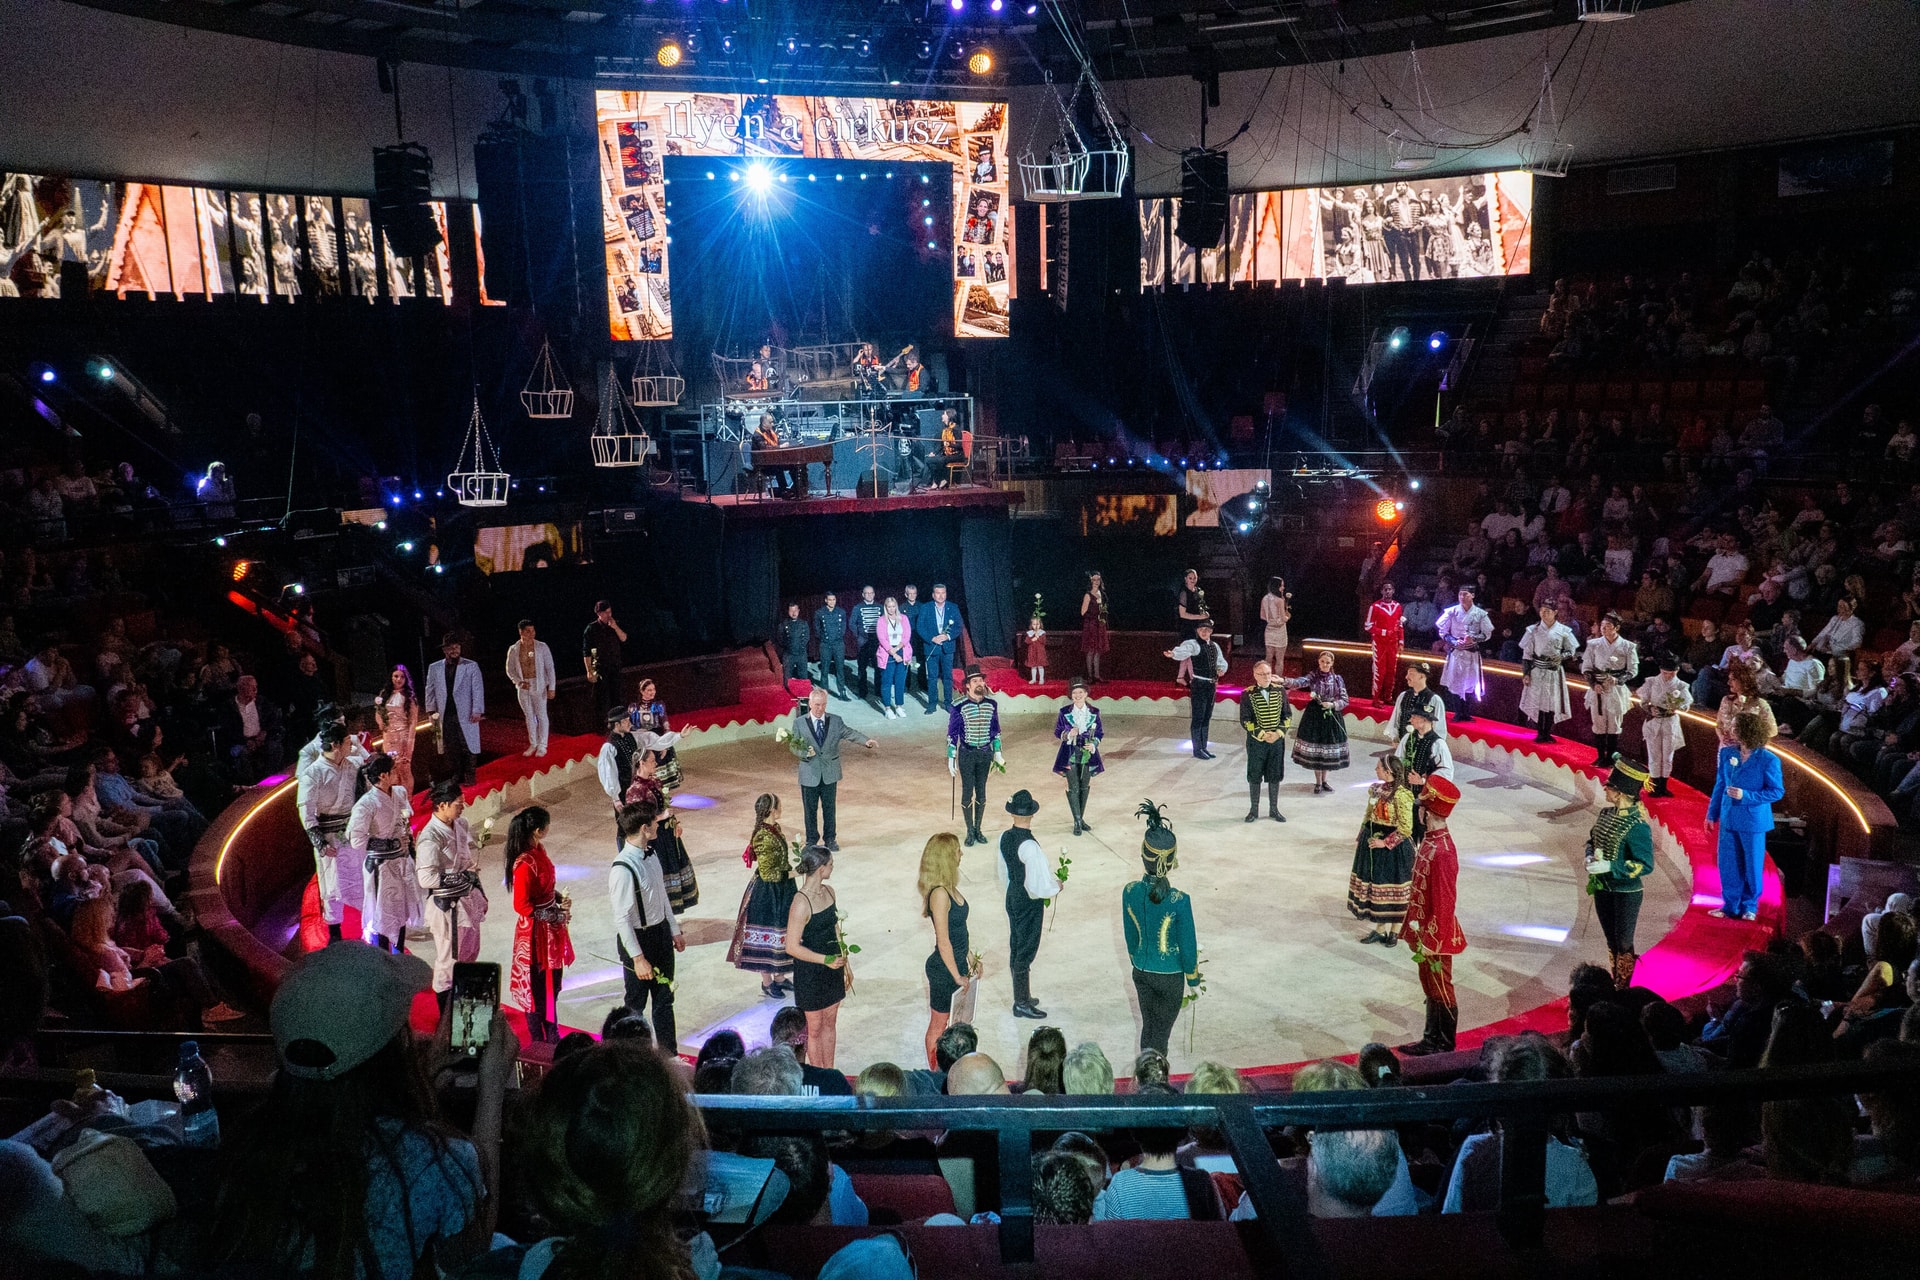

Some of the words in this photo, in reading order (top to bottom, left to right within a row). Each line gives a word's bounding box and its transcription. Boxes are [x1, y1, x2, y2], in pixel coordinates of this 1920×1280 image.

[664, 100, 766, 149] Ilyen
[780, 115, 804, 141] a
[815, 105, 950, 145] cirkusz
